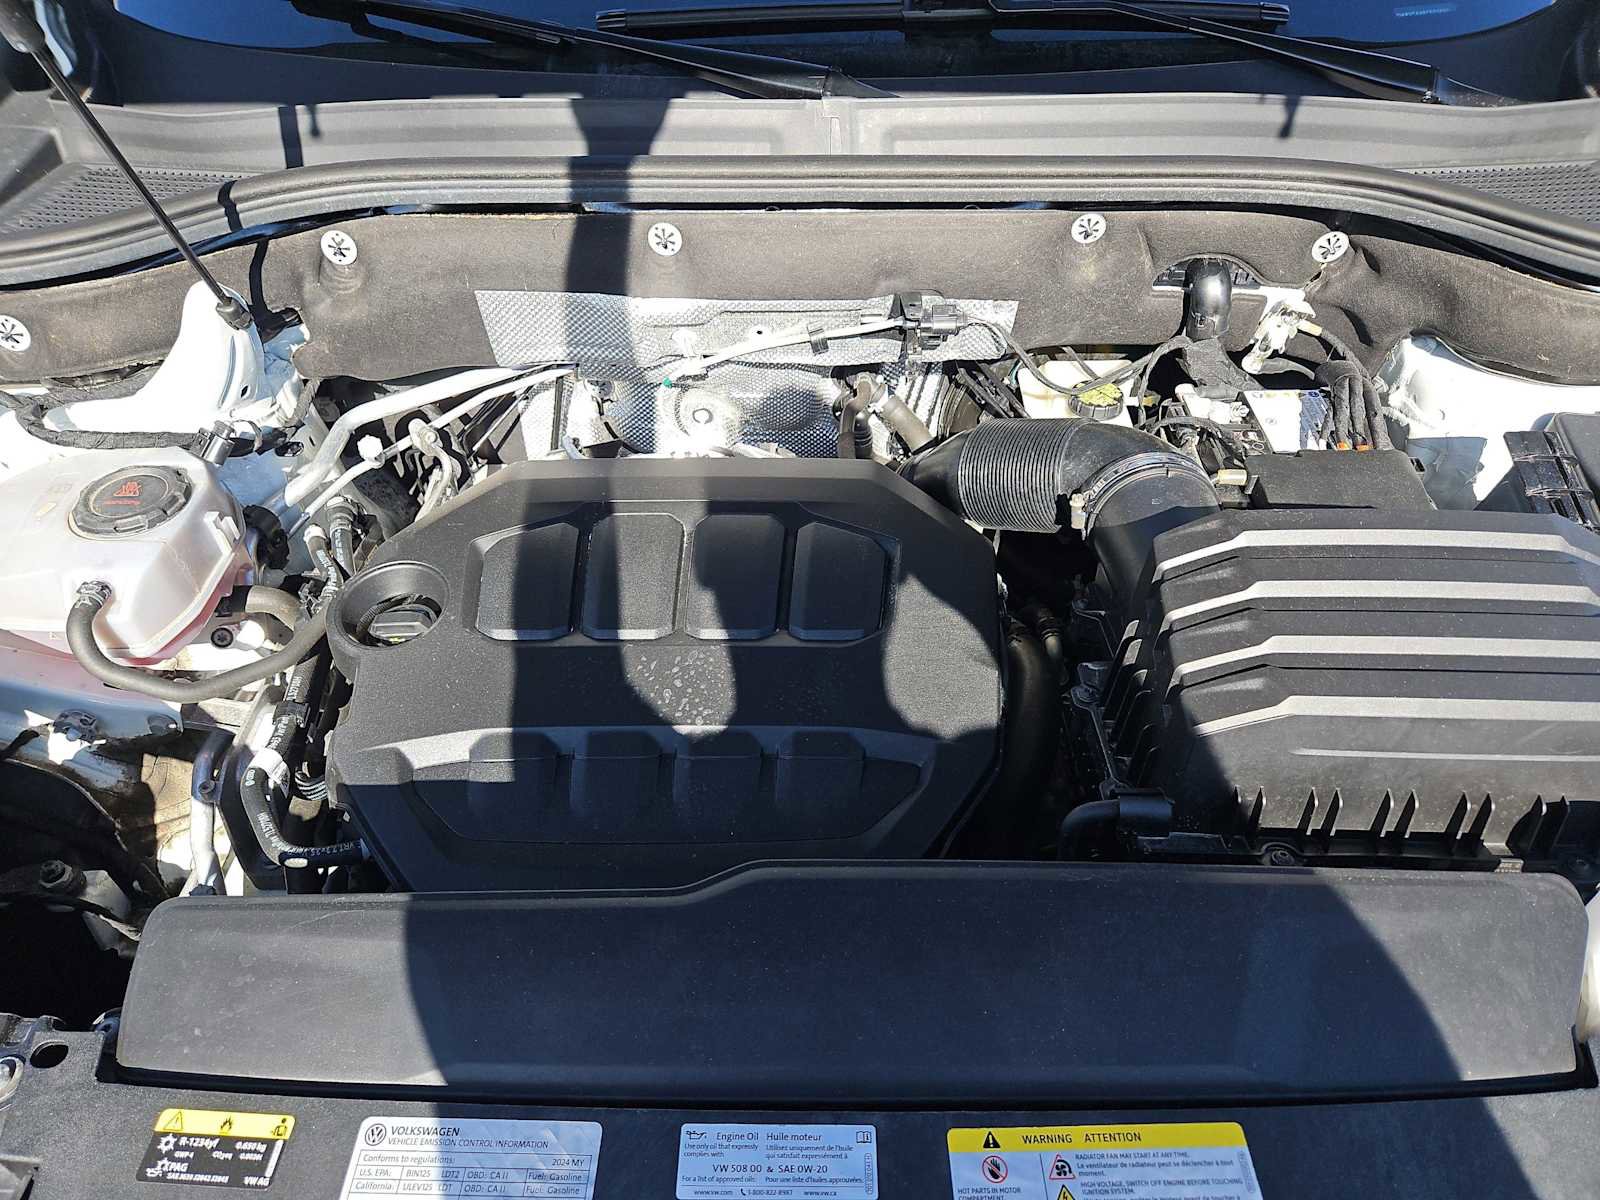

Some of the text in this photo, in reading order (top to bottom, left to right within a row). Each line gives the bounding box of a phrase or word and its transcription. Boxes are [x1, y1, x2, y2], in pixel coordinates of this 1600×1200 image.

[391, 1125, 460, 1137] VOLKSWAGEN
[717, 1132, 759, 1143] Engine Oil
[766, 1132, 788, 1141] Huile
[1022, 1132, 1142, 1145] WARNING ATTENTION
[179, 1136, 220, 1150] R-1234yf
[257, 1142, 268, 1153] kg
[388, 1137, 549, 1149] VEHICLE EMISSION CONTROL INFORMATION
[696, 1143, 709, 1151] only
[732, 1143, 758, 1151] expressly
[363, 1153, 585, 1167] Conforms to regulations: 2024 MY
[169, 1162, 189, 1172] PAG
[713, 1164, 828, 1174] VW 508 00 & SAE 0W-20
[406, 1169, 431, 1178] BIN125
[441, 1170, 460, 1178] LDT2
[467, 1171, 487, 1179] OBD:
[490, 1171, 501, 1179] CA
[549, 1173, 582, 1181] Gasoline
[716, 1176, 744, 1184] approved
[244, 1176, 270, 1186] VW AG
[464, 1184, 484, 1192] OBD:
[487, 1184, 498, 1193] CA
[547, 1185, 580, 1194] Gasoline
[957, 1187, 969, 1195] HOT
